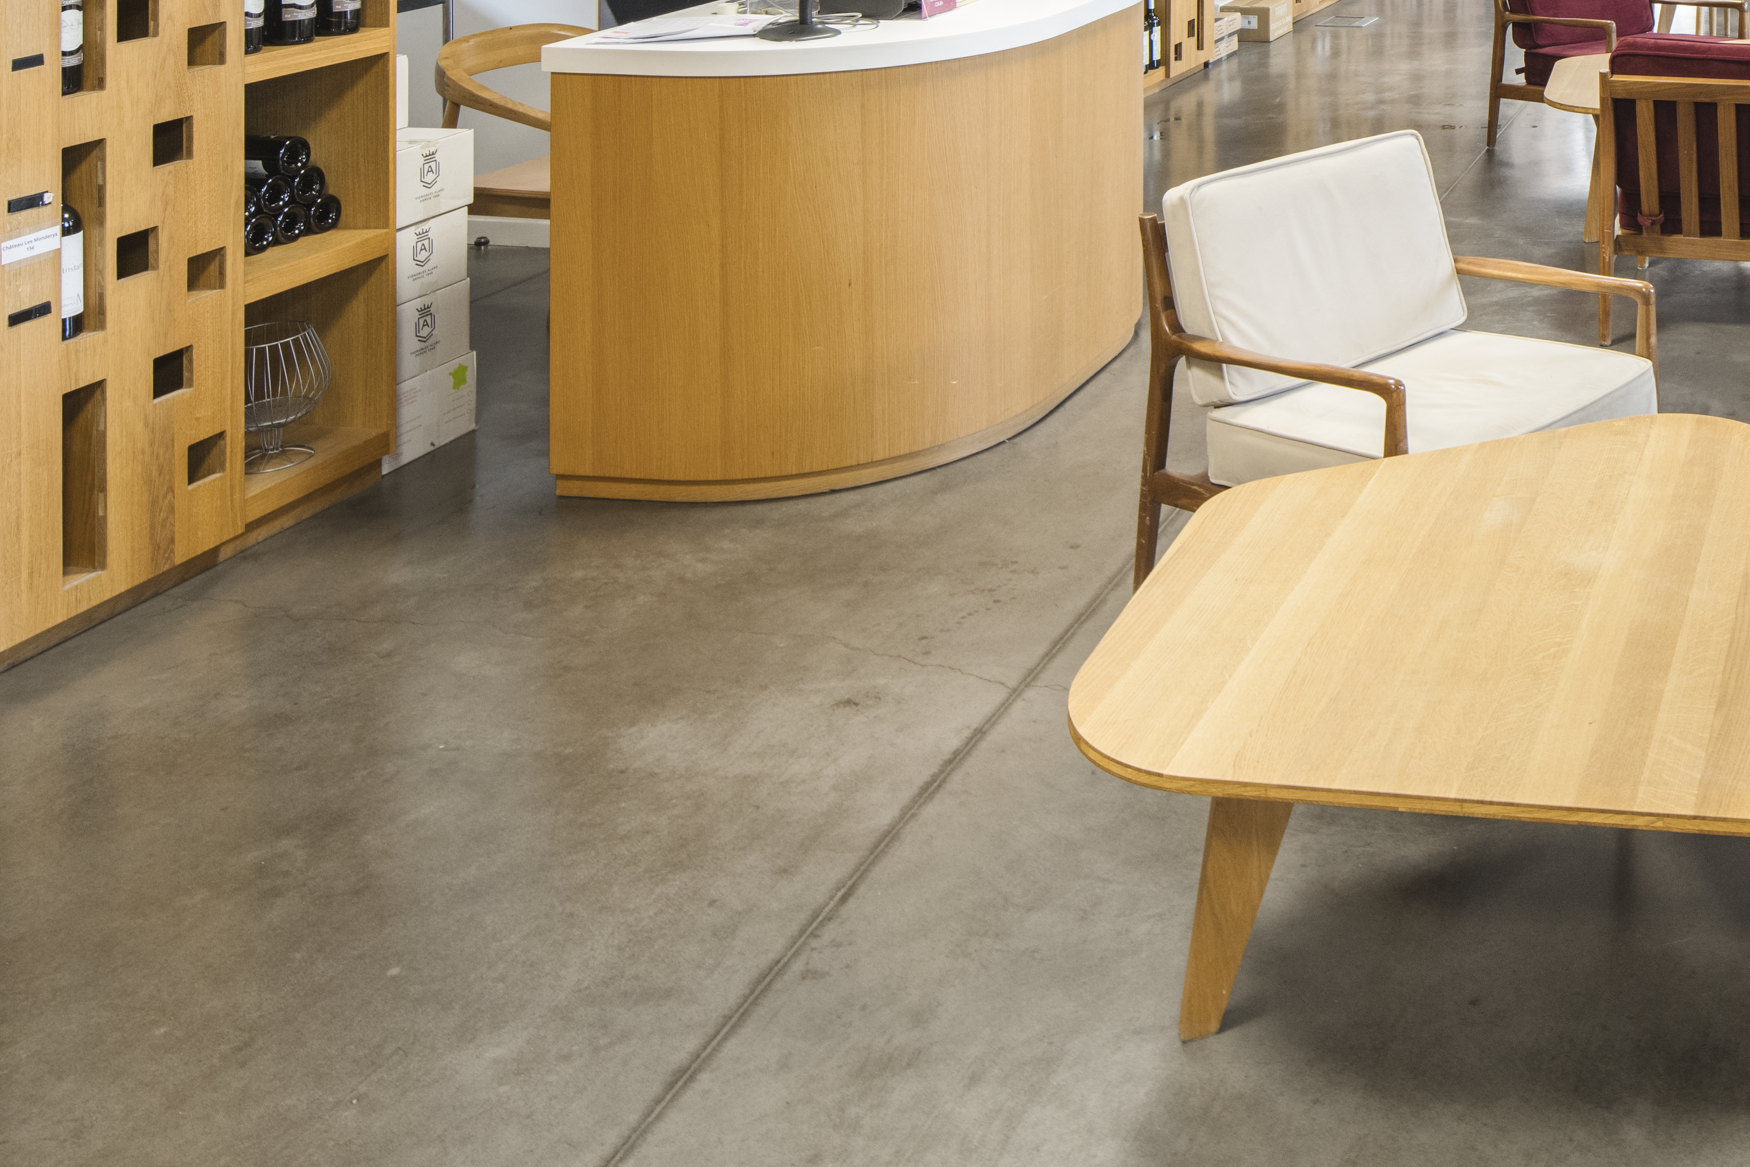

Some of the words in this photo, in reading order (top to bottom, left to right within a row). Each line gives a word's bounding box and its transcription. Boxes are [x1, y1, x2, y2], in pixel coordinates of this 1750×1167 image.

[426, 165, 435, 176] A
[2, 241, 24, 252] Château
[34, 232, 58, 243] Monderys
[419, 243, 428, 254] A
[421, 319, 430, 330] A
